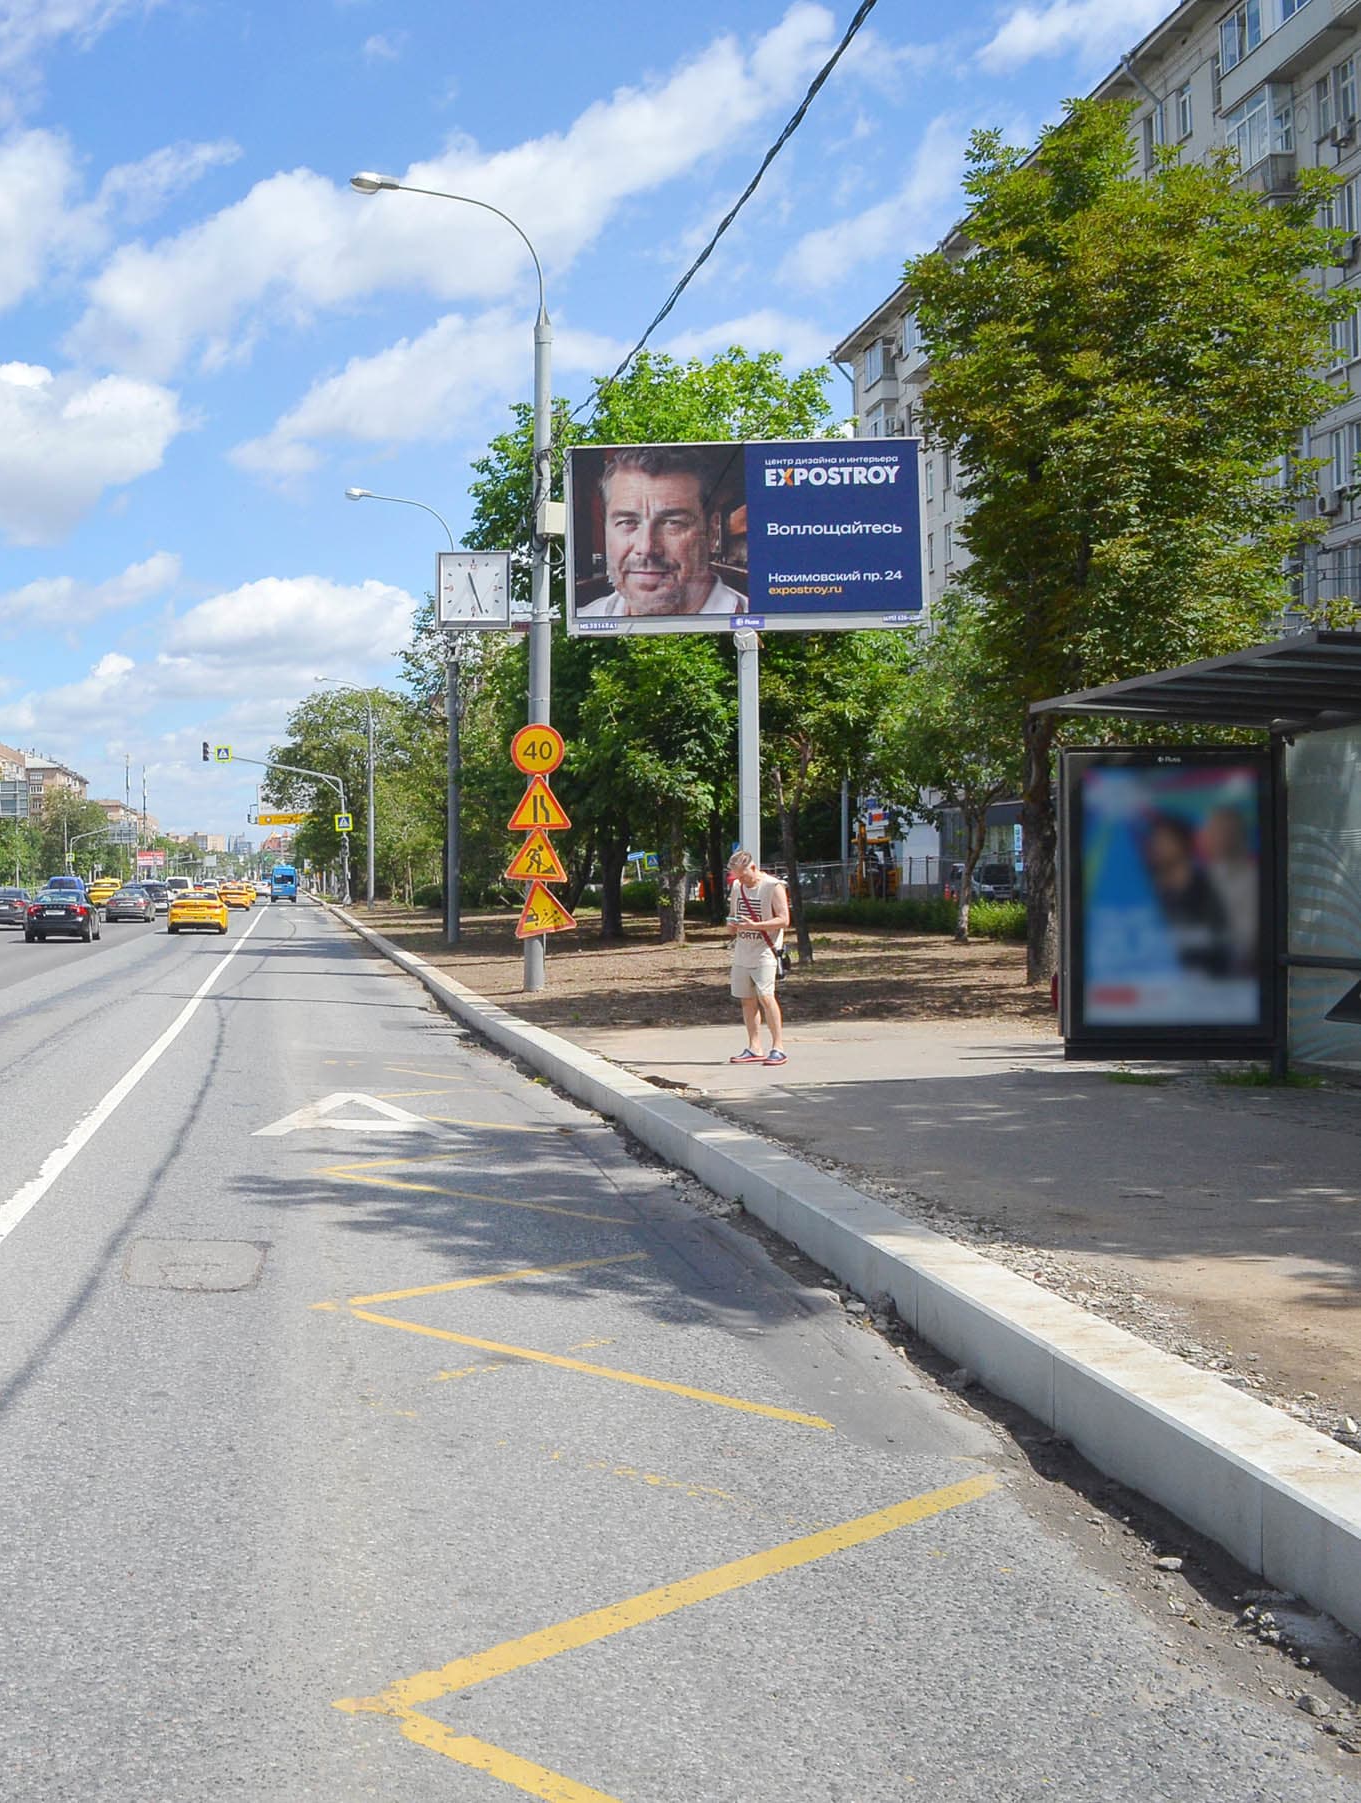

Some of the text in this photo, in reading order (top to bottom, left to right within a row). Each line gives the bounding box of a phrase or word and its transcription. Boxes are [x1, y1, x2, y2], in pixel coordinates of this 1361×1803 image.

[765, 458, 794, 466] центр
[795, 456, 837, 464] дизайна
[765, 465, 900, 486] EXPOSTROY
[767, 521, 903, 536] Воплощайтесь
[768, 570, 903, 583] Нахимовский пр. 24
[768, 585, 842, 596] expostroy.ru
[523, 741, 552, 760] 40
